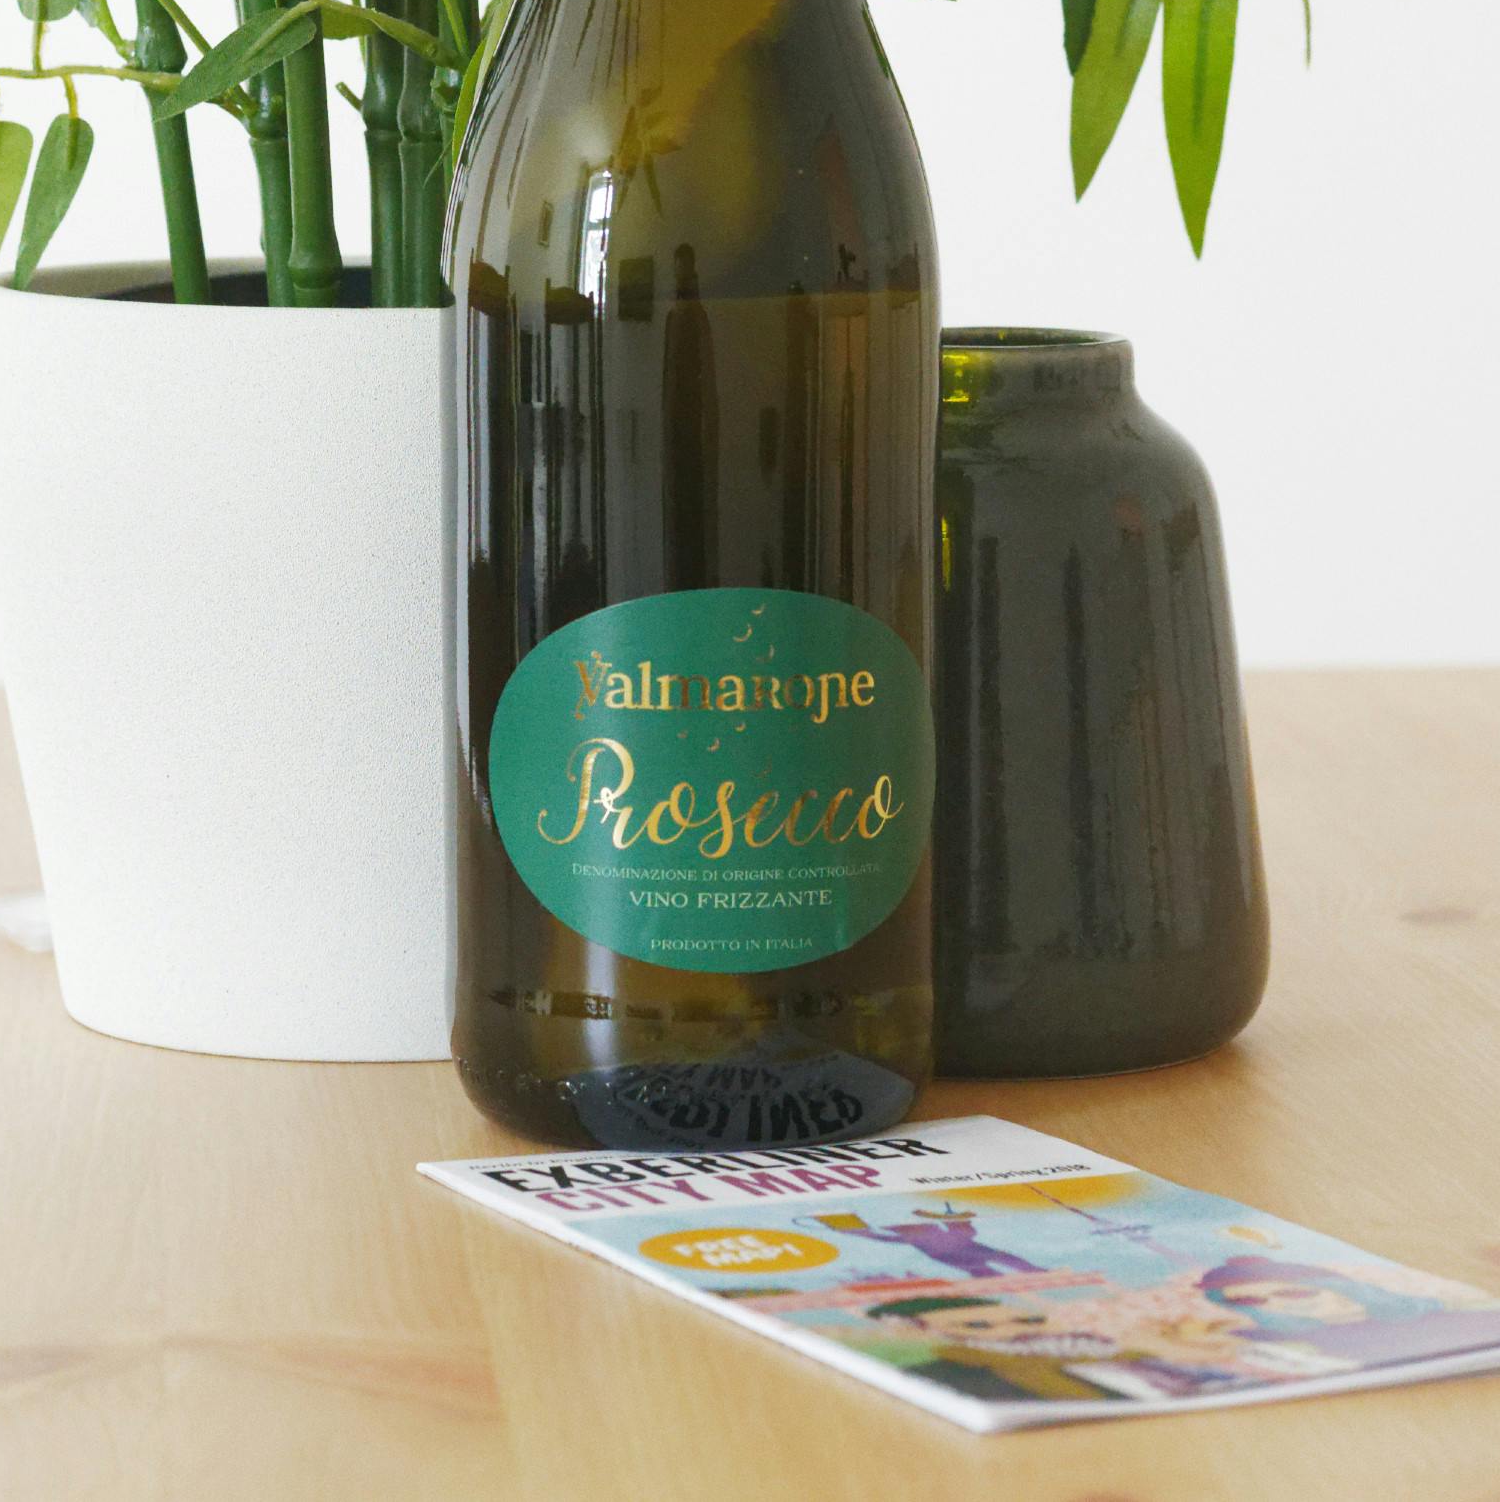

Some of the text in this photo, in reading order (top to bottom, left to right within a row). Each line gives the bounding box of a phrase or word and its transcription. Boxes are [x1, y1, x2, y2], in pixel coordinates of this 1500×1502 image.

[537, 737, 905, 860] Prosecco
[571, 863, 698, 882] DENOMINAZIONE
[702, 870, 717, 882] DI
[722, 869, 784, 882] ORIGINE
[629, 889, 833, 910] VINO FRIZZANTE
[651, 937, 813, 952] PRODOTTO IN ITALIA
[481, 1138, 952, 1192] EXBERLINER
[535, 1164, 883, 1212] CITY MAP
